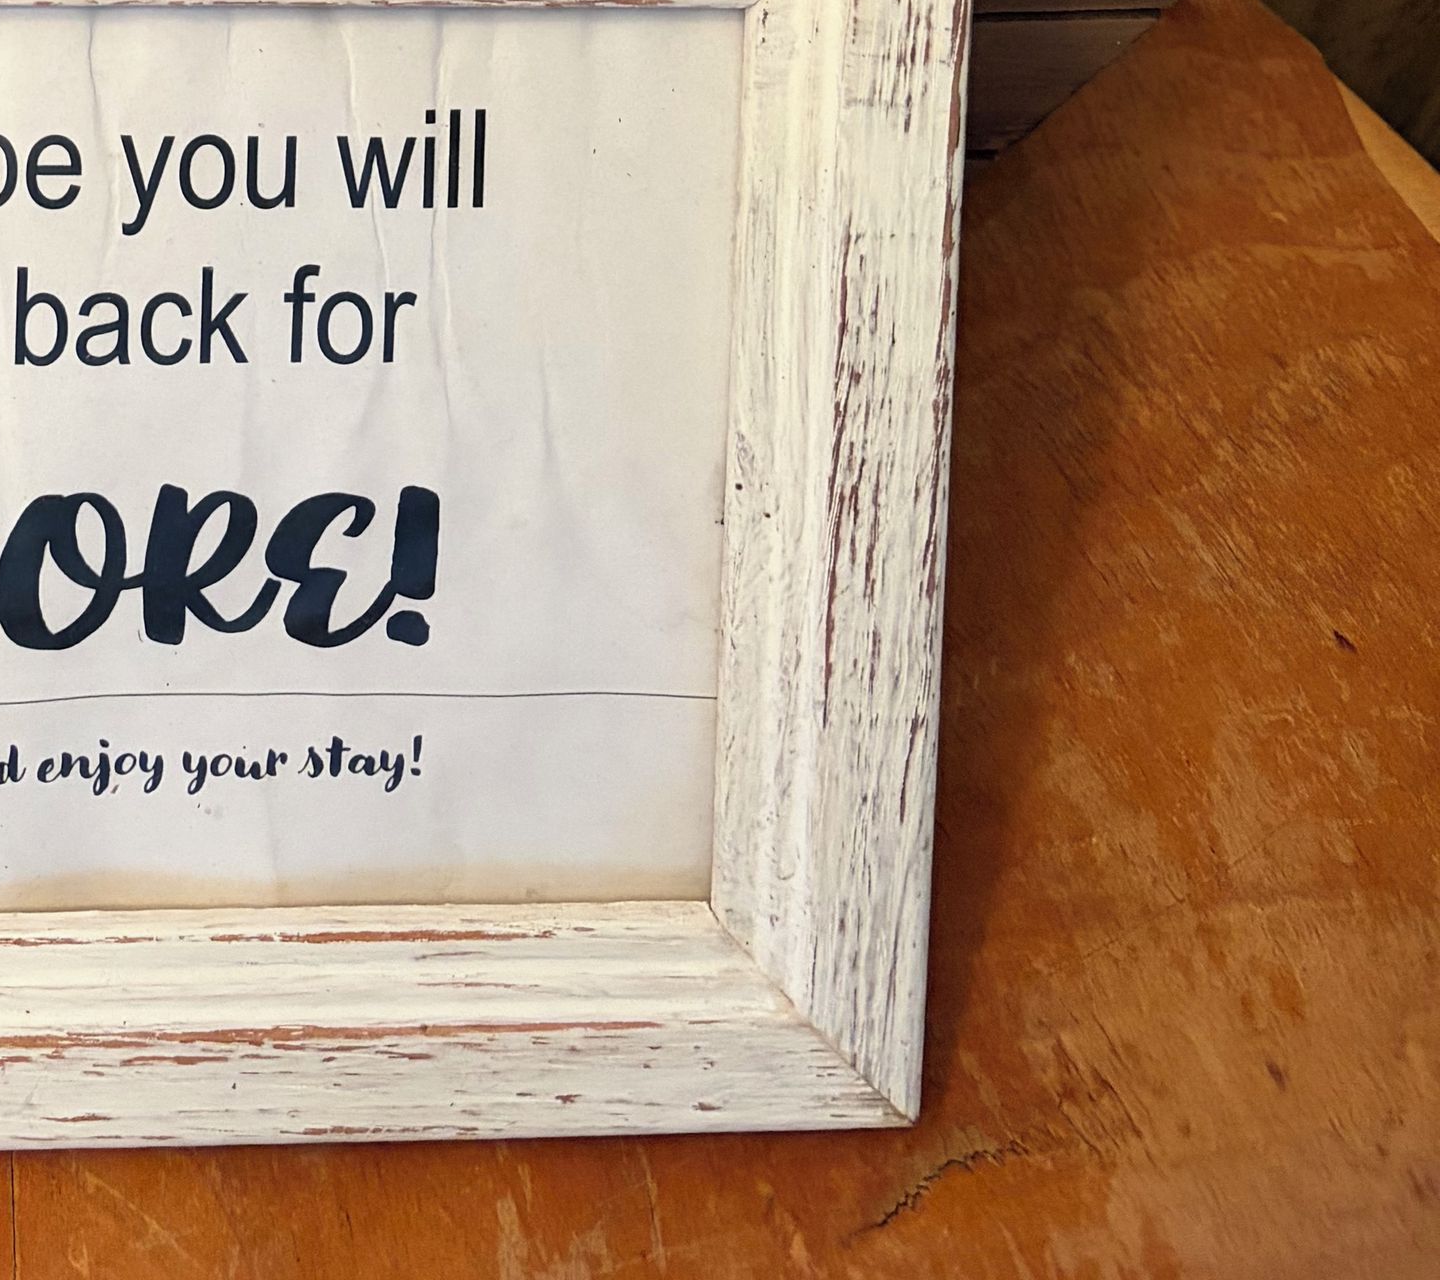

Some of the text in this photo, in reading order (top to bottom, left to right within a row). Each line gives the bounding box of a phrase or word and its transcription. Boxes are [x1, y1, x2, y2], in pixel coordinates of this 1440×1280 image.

[120, 134, 297, 236] you
[336, 109, 486, 209] will
[14, 266, 249, 367] back
[283, 264, 418, 365] for
[35, 741, 166, 796] enjoy
[182, 744, 290, 795] your
[299, 735, 423, 791] stay!
